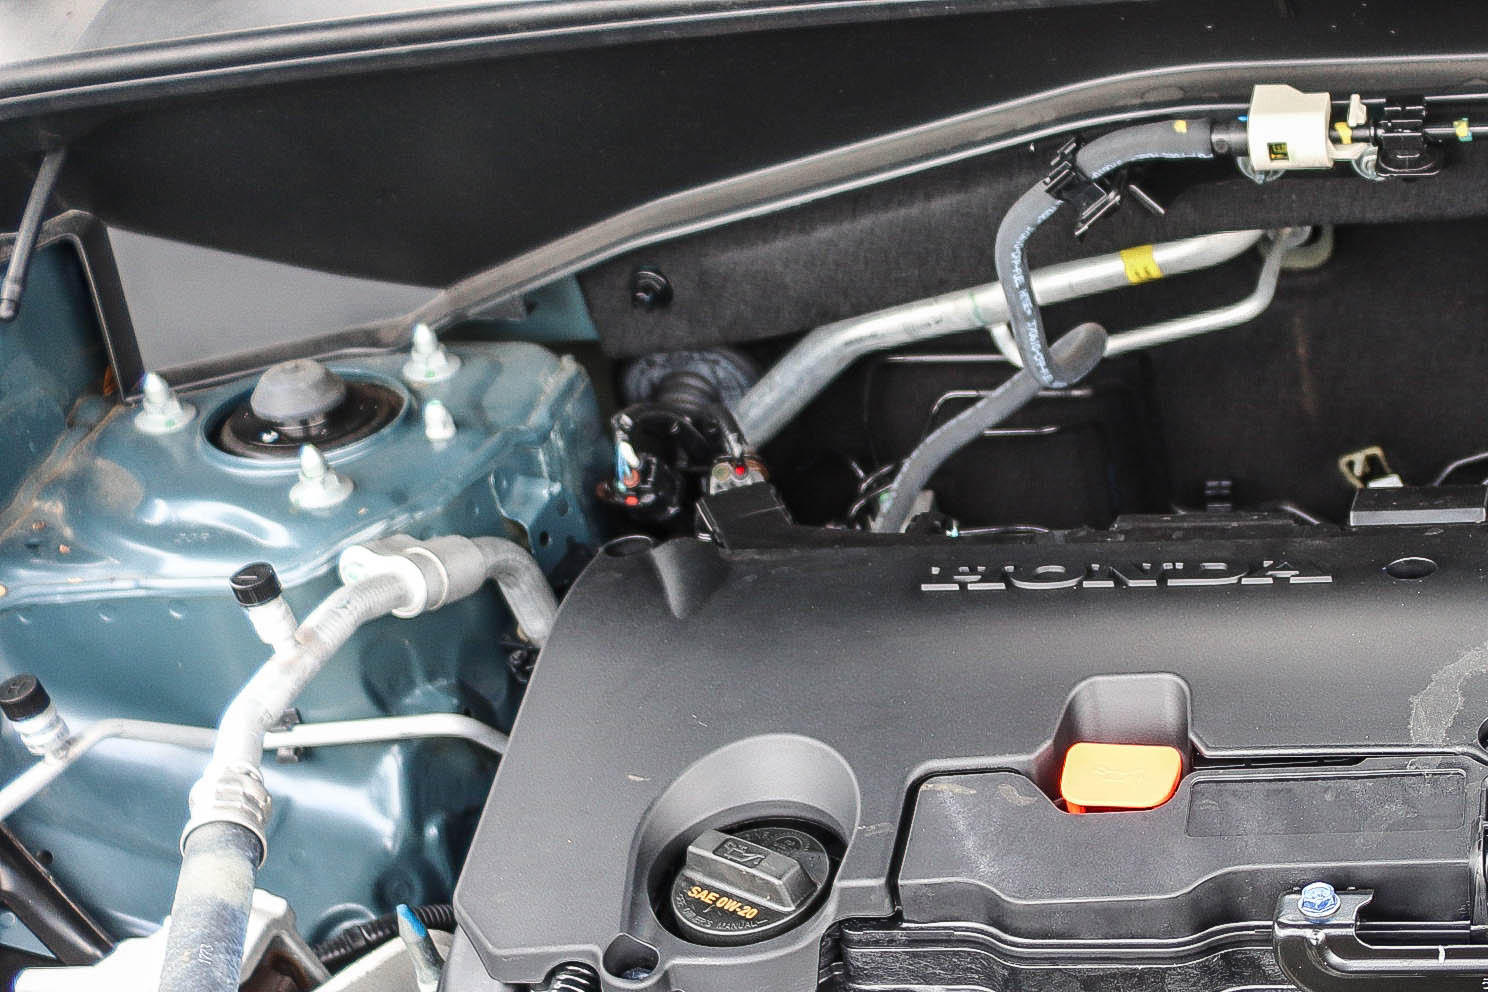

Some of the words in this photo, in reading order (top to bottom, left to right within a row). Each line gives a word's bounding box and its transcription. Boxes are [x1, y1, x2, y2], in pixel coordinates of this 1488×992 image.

[920, 560, 1334, 591] HONDA
[688, 886, 719, 905] SAE
[715, 896, 758, 919] 0W-20
